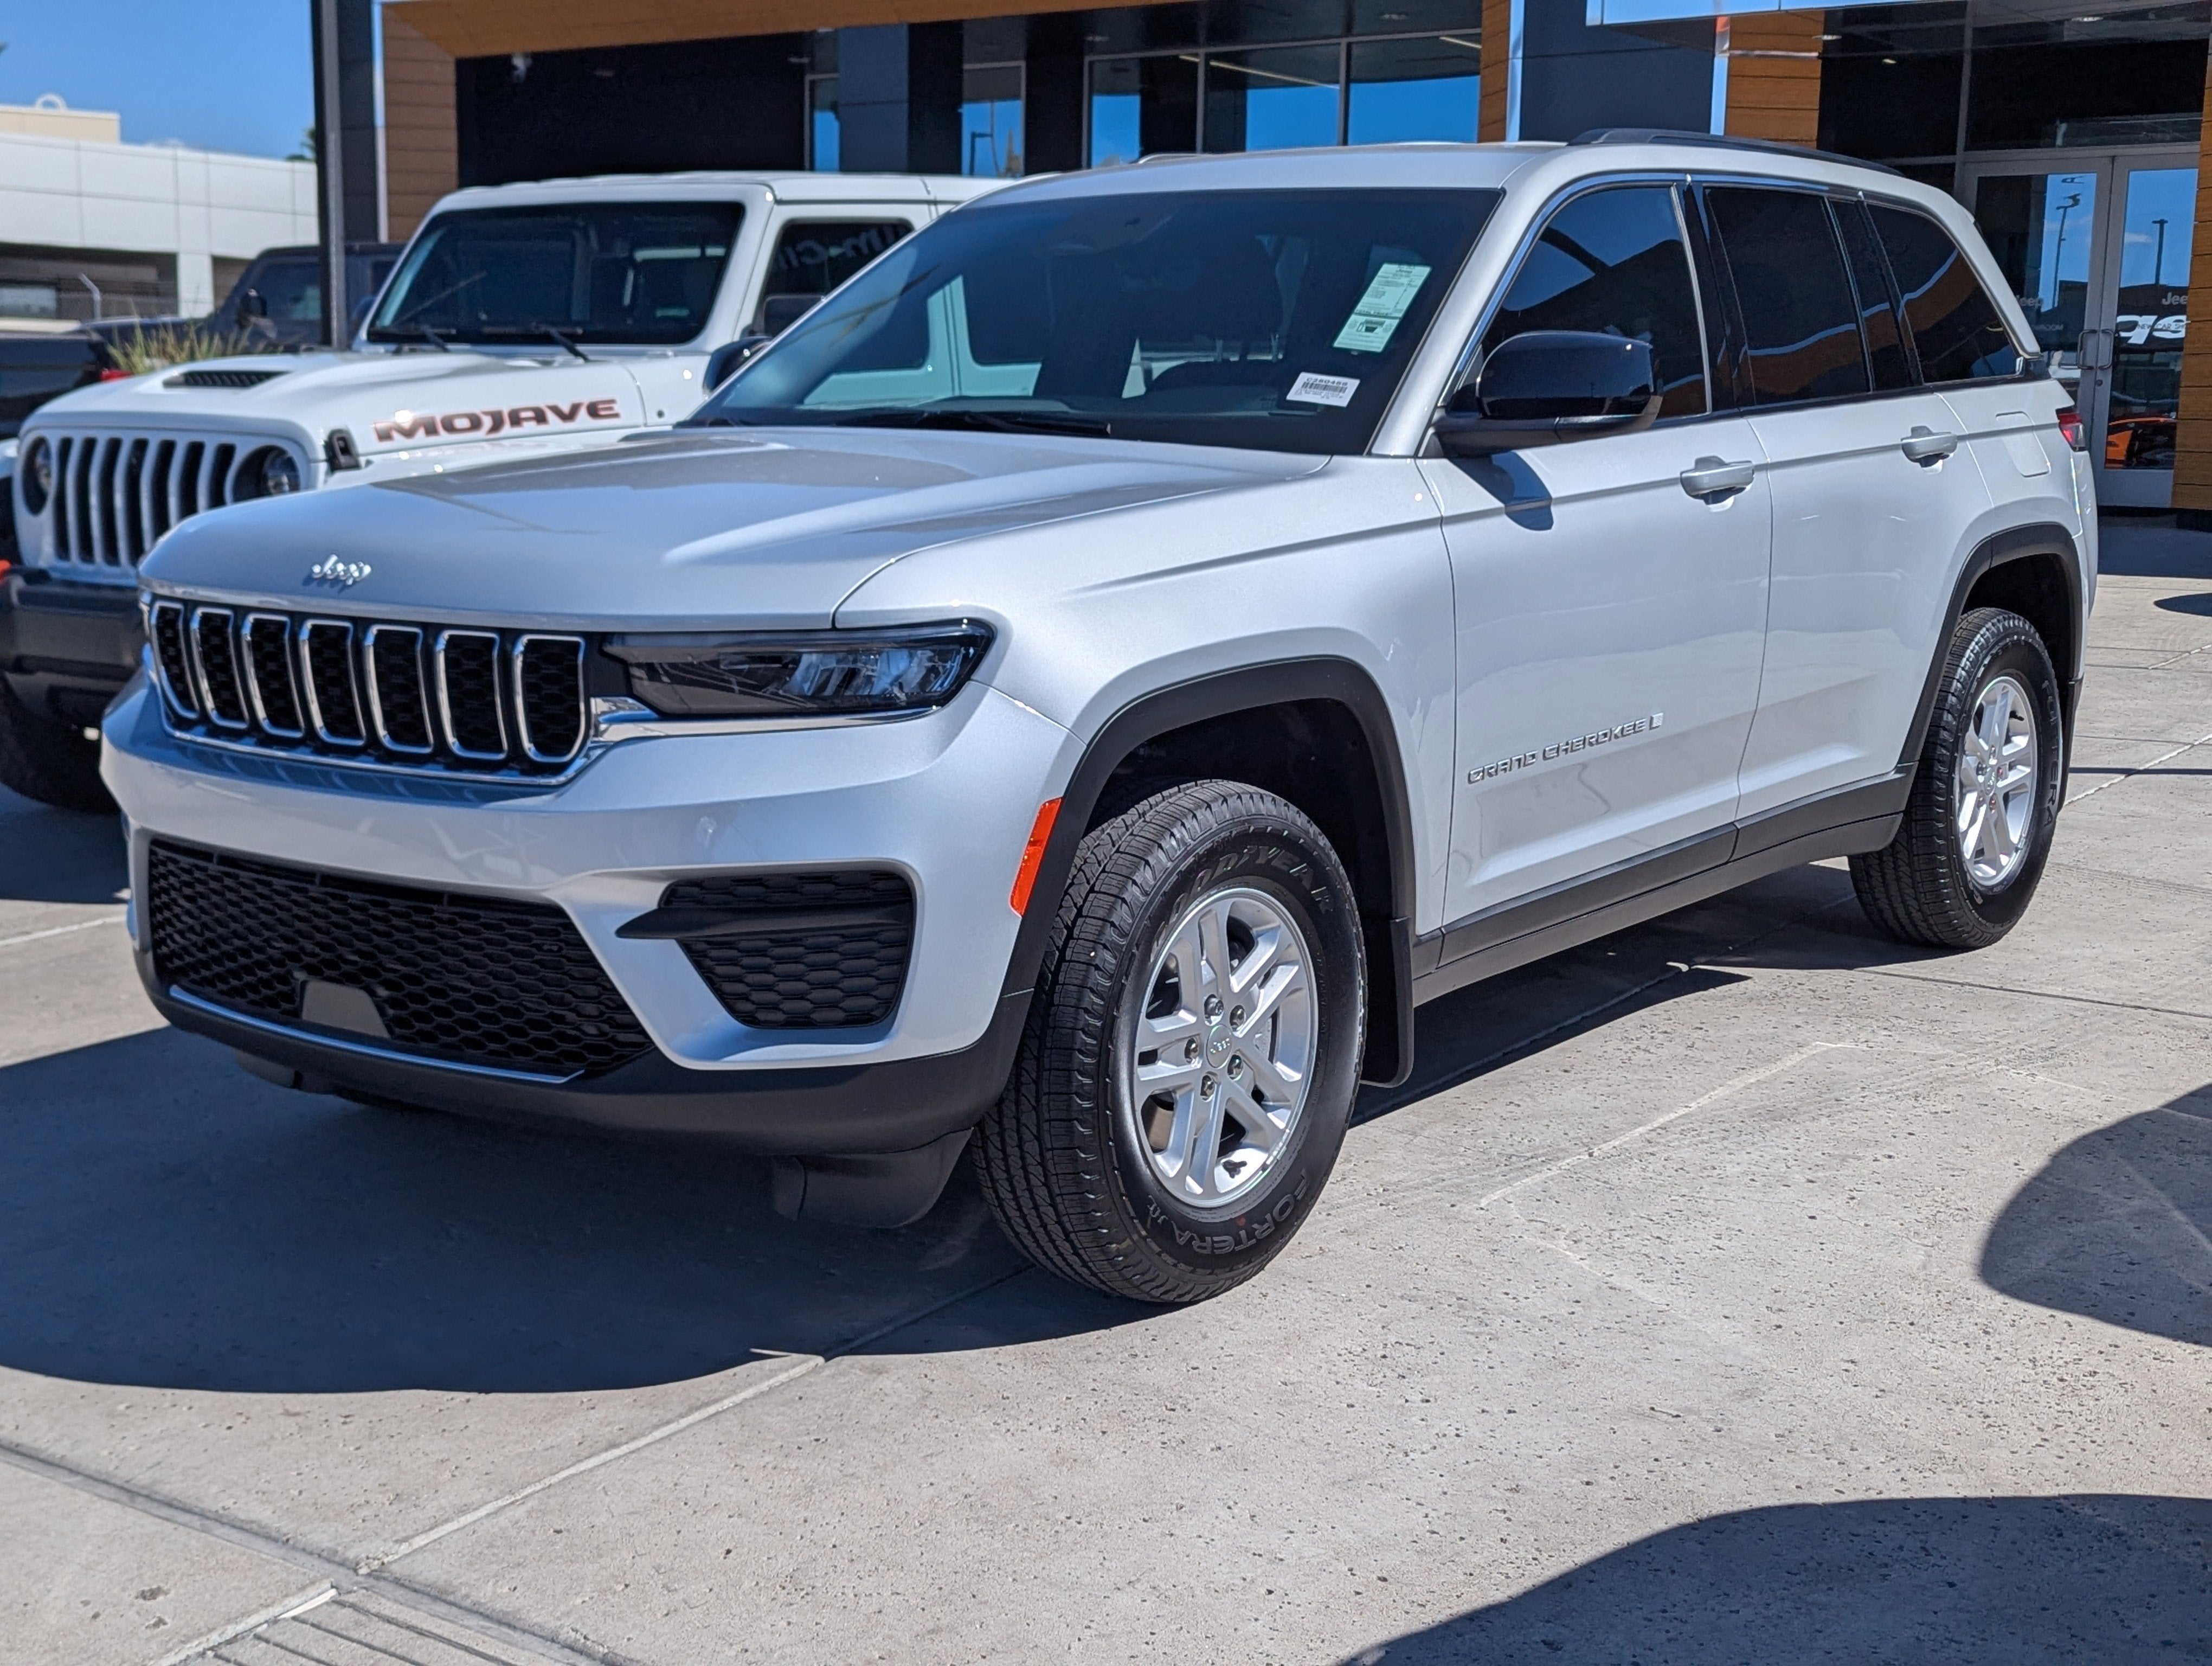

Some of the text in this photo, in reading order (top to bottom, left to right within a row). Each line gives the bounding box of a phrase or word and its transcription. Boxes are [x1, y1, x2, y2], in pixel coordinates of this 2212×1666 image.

[2016, 295, 2044, 309] eep
[2162, 292, 2188, 305] Jee
[372, 398, 621, 443] MOJAVE
[311, 554, 372, 586] Jeep
[1467, 717, 1647, 784] GRAND CHEROKEE
[1170, 1168, 1311, 1255] FORTERA
